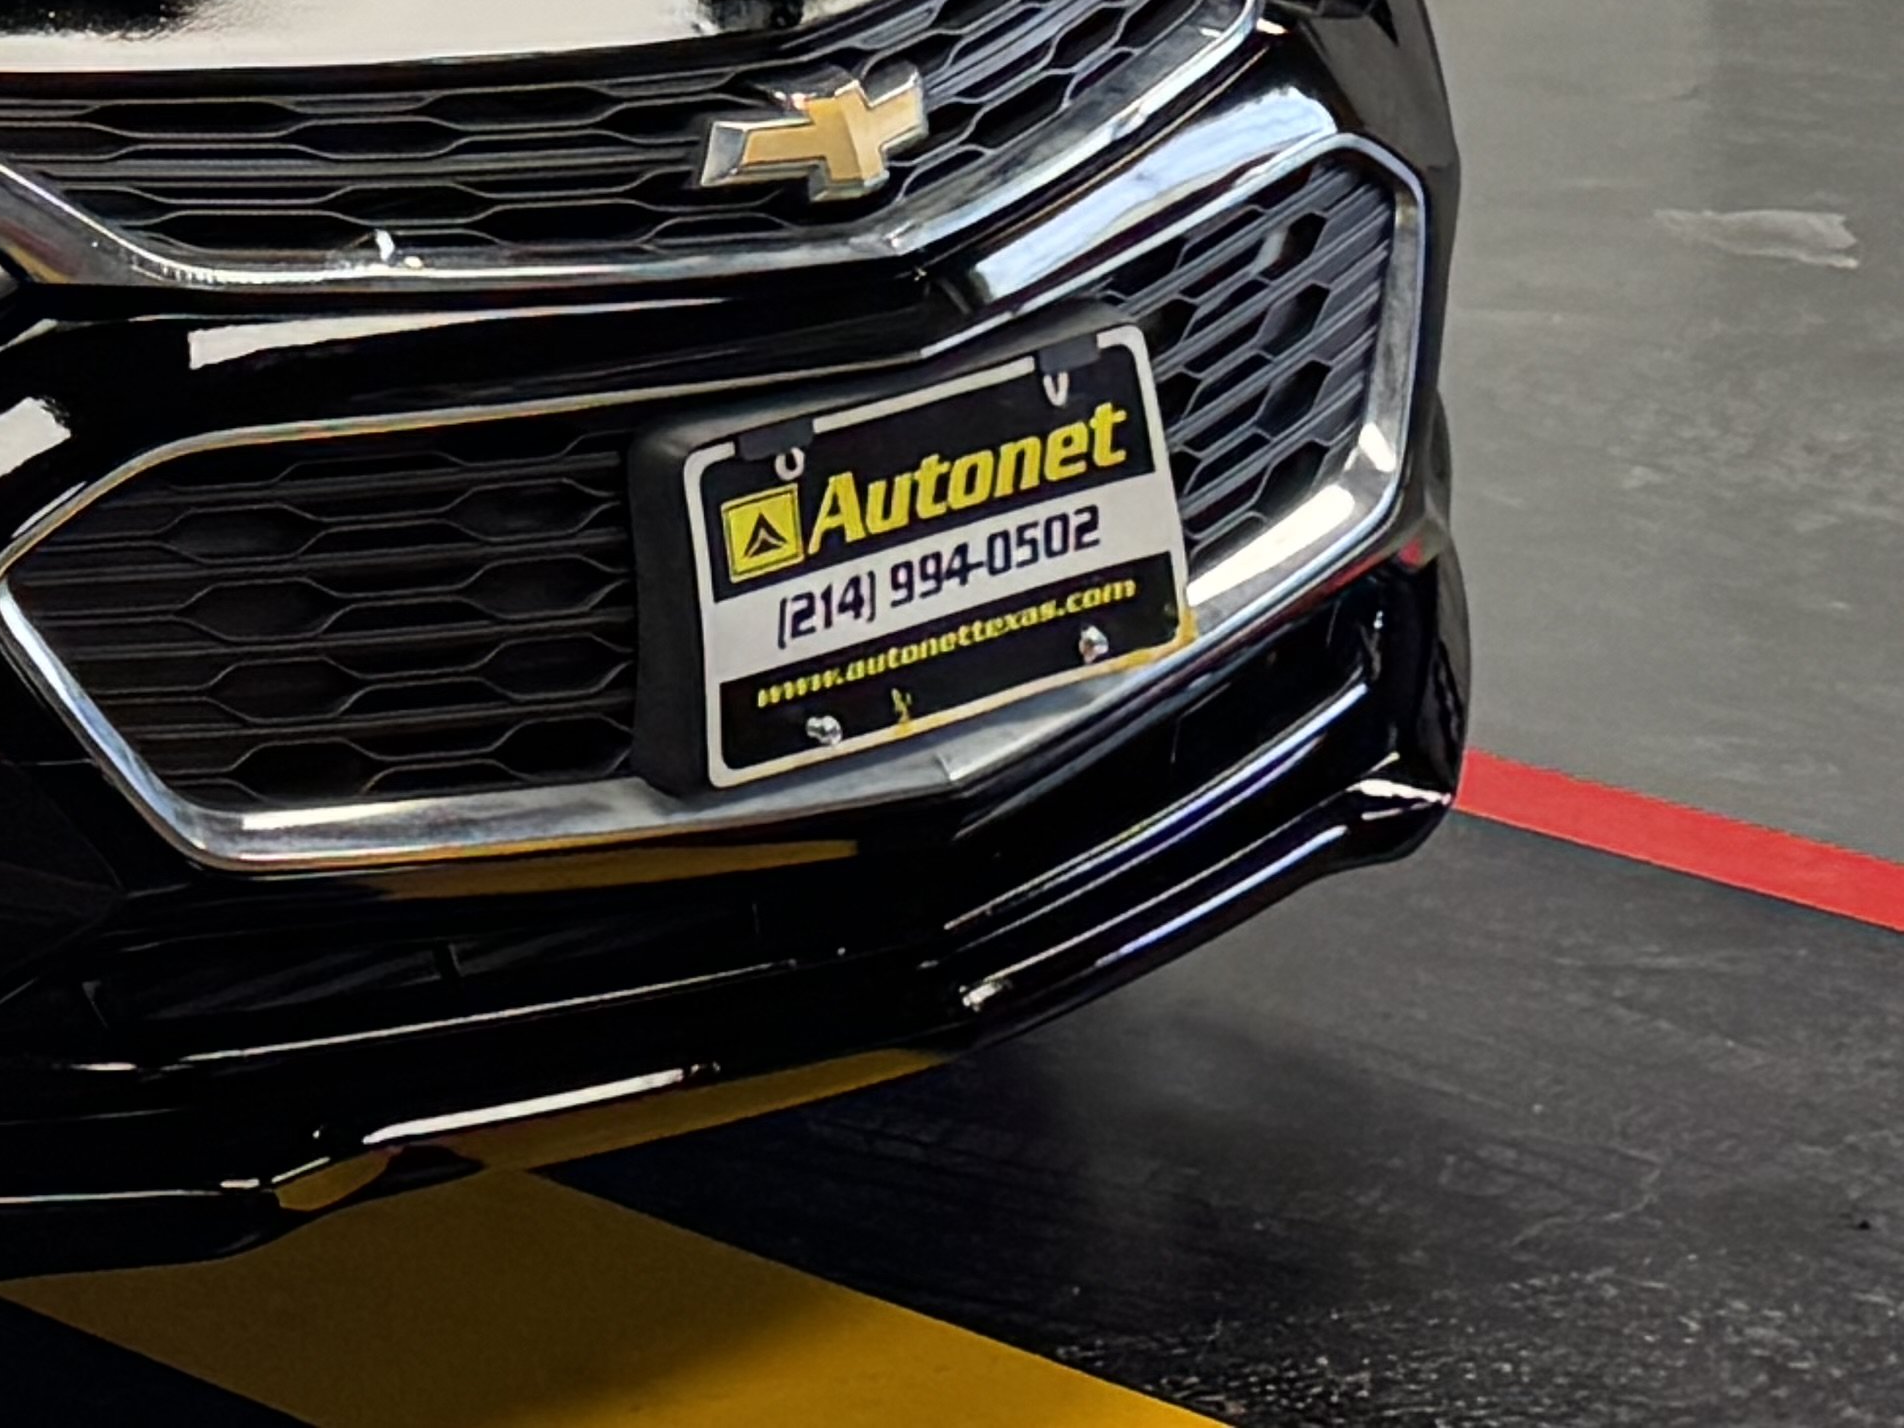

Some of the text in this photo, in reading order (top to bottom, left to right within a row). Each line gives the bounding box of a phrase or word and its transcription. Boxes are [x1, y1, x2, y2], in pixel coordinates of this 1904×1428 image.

[807, 401, 1127, 555] Autonet
[756, 578, 1137, 709] www.autonettexas.com
[777, 504, 1101, 649] (214) 994-0502
